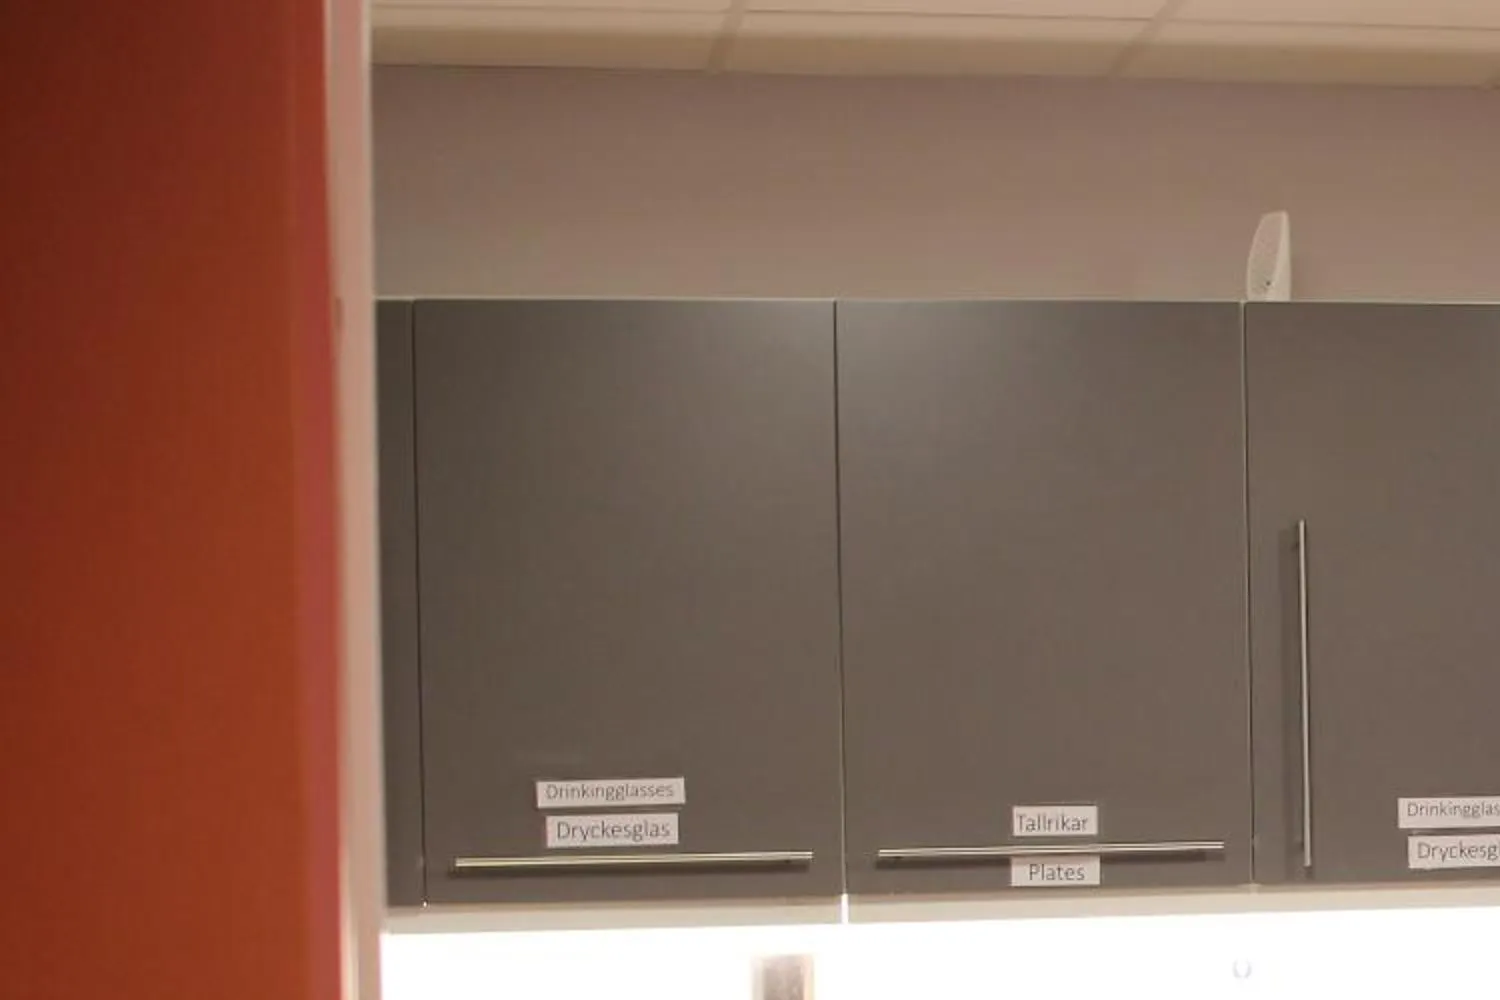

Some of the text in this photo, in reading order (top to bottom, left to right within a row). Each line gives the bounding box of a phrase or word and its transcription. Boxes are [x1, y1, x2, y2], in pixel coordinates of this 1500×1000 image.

[546, 782, 674, 801] Drinkingglasses
[556, 819, 671, 842] Dryckesglas
[1017, 812, 1089, 832] Tallrikar
[1029, 863, 1085, 881] Plates
